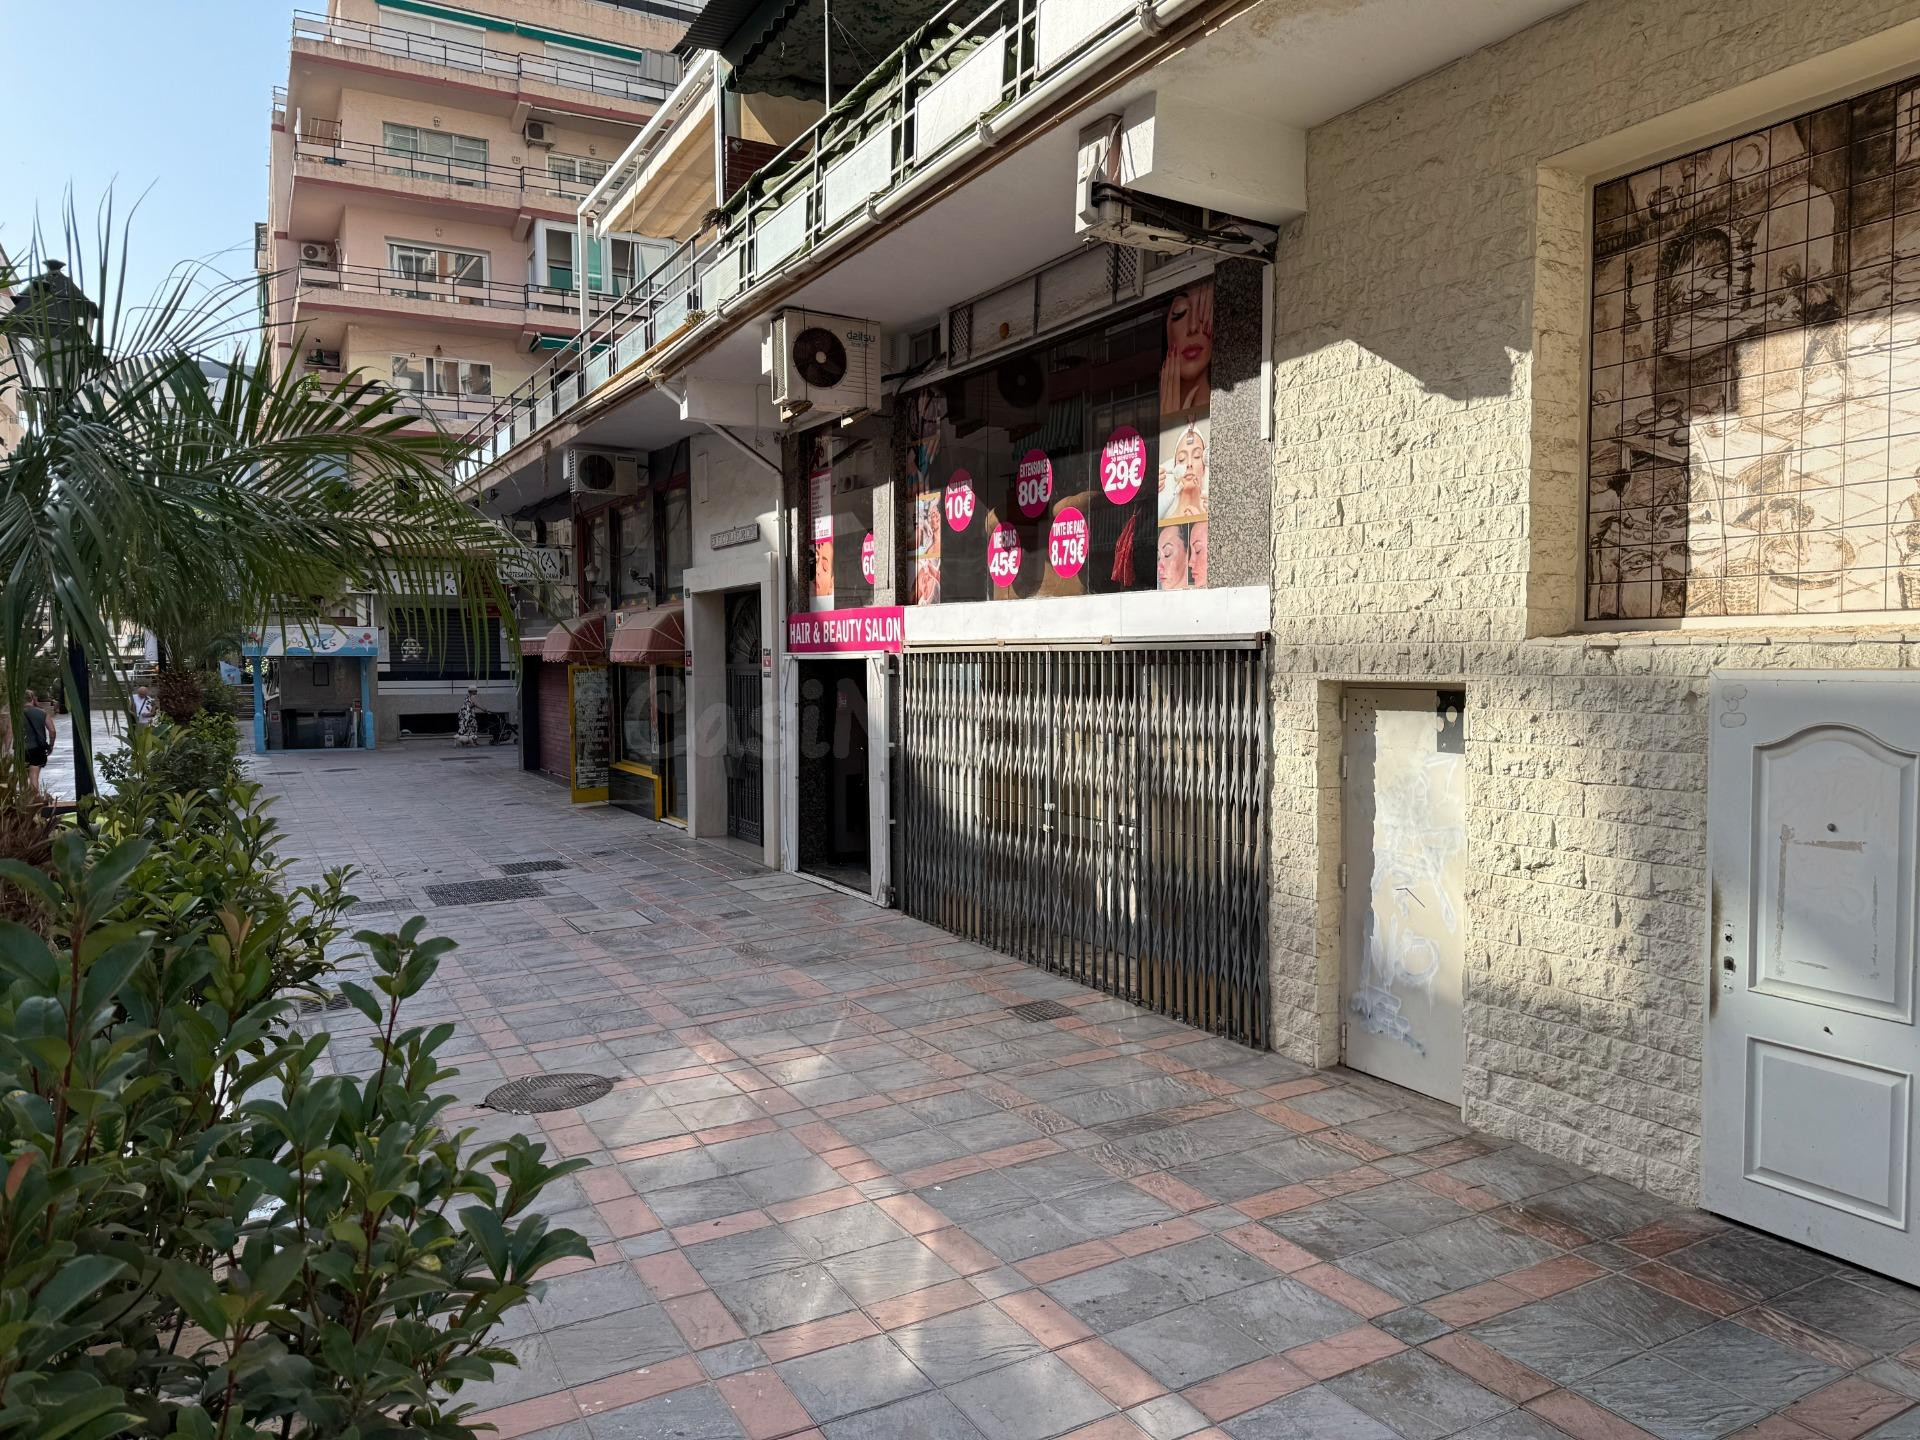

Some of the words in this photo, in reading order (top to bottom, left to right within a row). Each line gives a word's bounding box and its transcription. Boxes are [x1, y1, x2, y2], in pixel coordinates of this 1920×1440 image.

[1106, 435, 1140, 458] MASAJE
[1019, 457, 1051, 478] EXTENSIONES
[1104, 457, 1142, 492] 29€
[1018, 475, 1051, 507] 80€
[946, 493, 973, 520] 10€
[993, 529, 1017, 549] MECHAS
[1067, 520, 1074, 535] DE
[989, 549, 1018, 576] 45€
[1051, 538, 1085, 567] 8.79€
[790, 622, 811, 645] HAIR
[813, 621, 820, 644] &
[823, 618, 863, 643] BEAUTY
[865, 616, 901, 642] SALON
